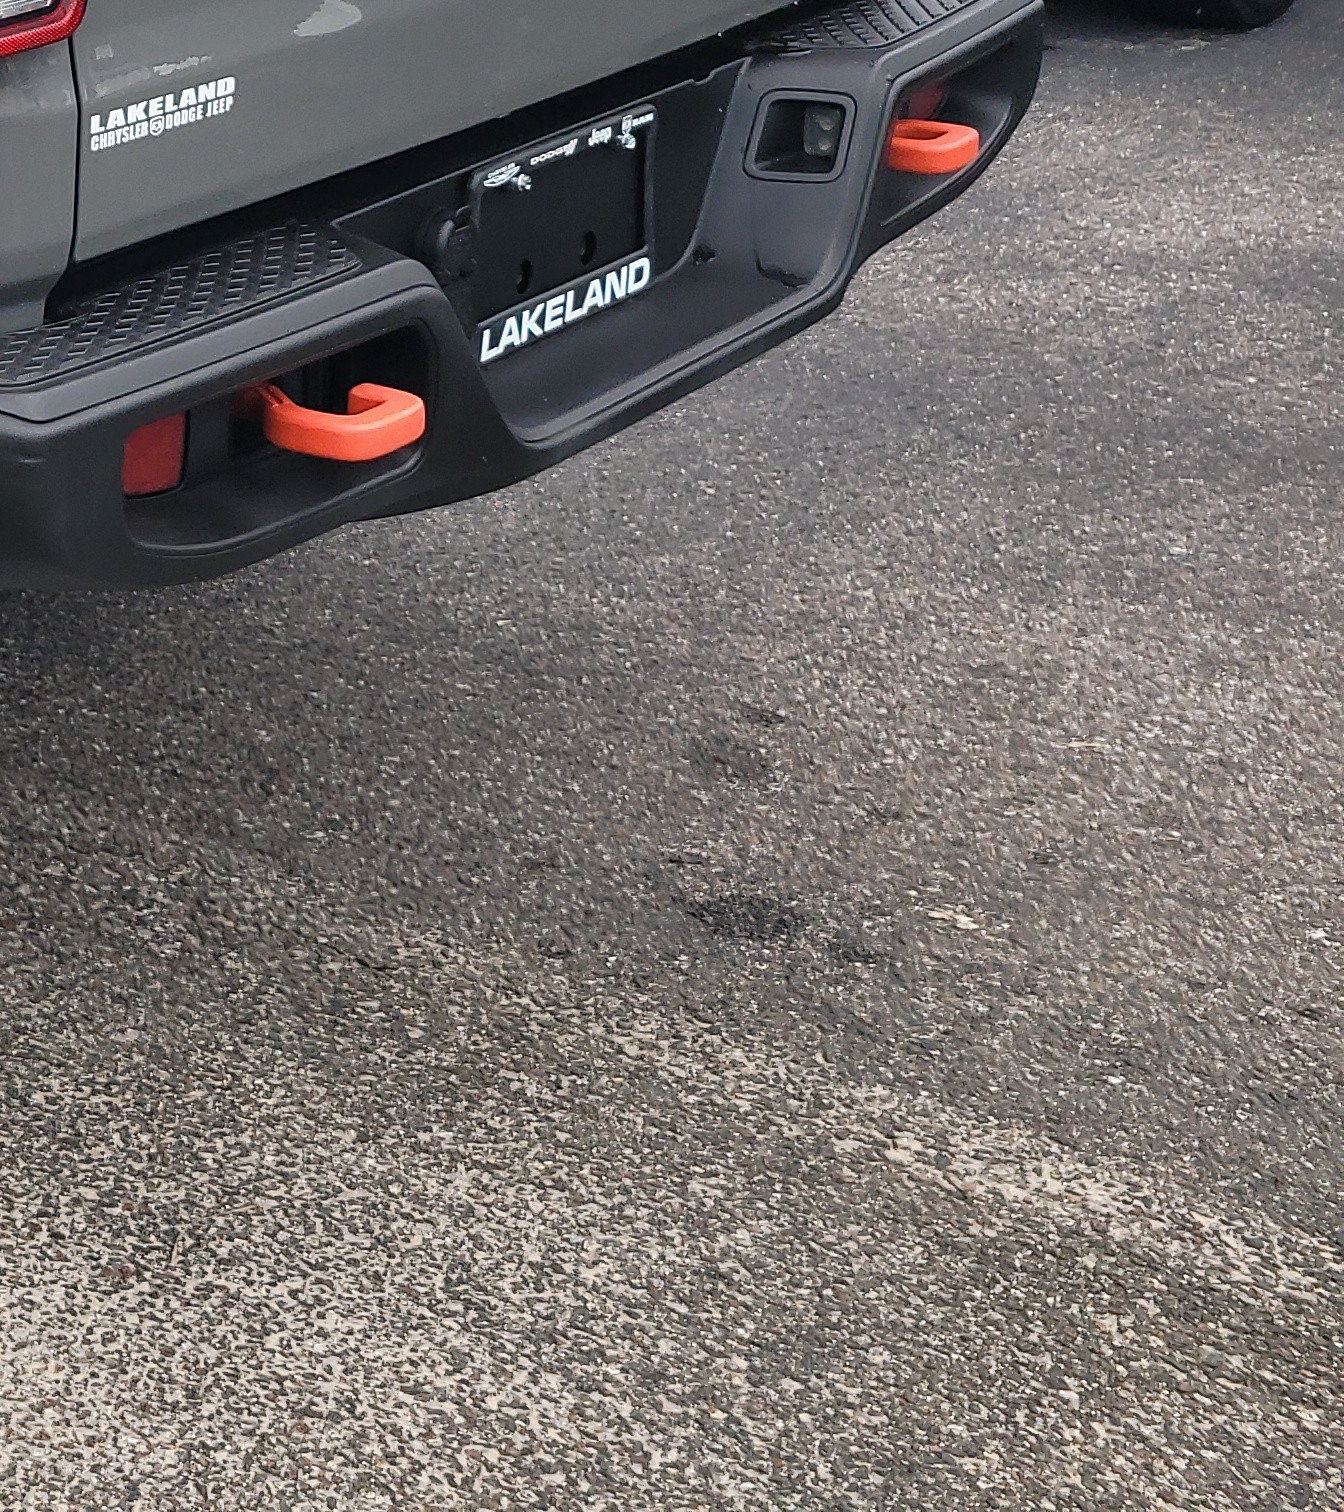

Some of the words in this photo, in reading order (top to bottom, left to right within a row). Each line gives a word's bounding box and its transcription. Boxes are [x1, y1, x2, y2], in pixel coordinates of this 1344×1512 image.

[90, 76, 236, 135] LAKELAND
[90, 121, 149, 151] CHRYSLER
[165, 104, 204, 130] DODGE
[205, 95, 235, 119] JEEP
[479, 256, 651, 364] LAKELAND
